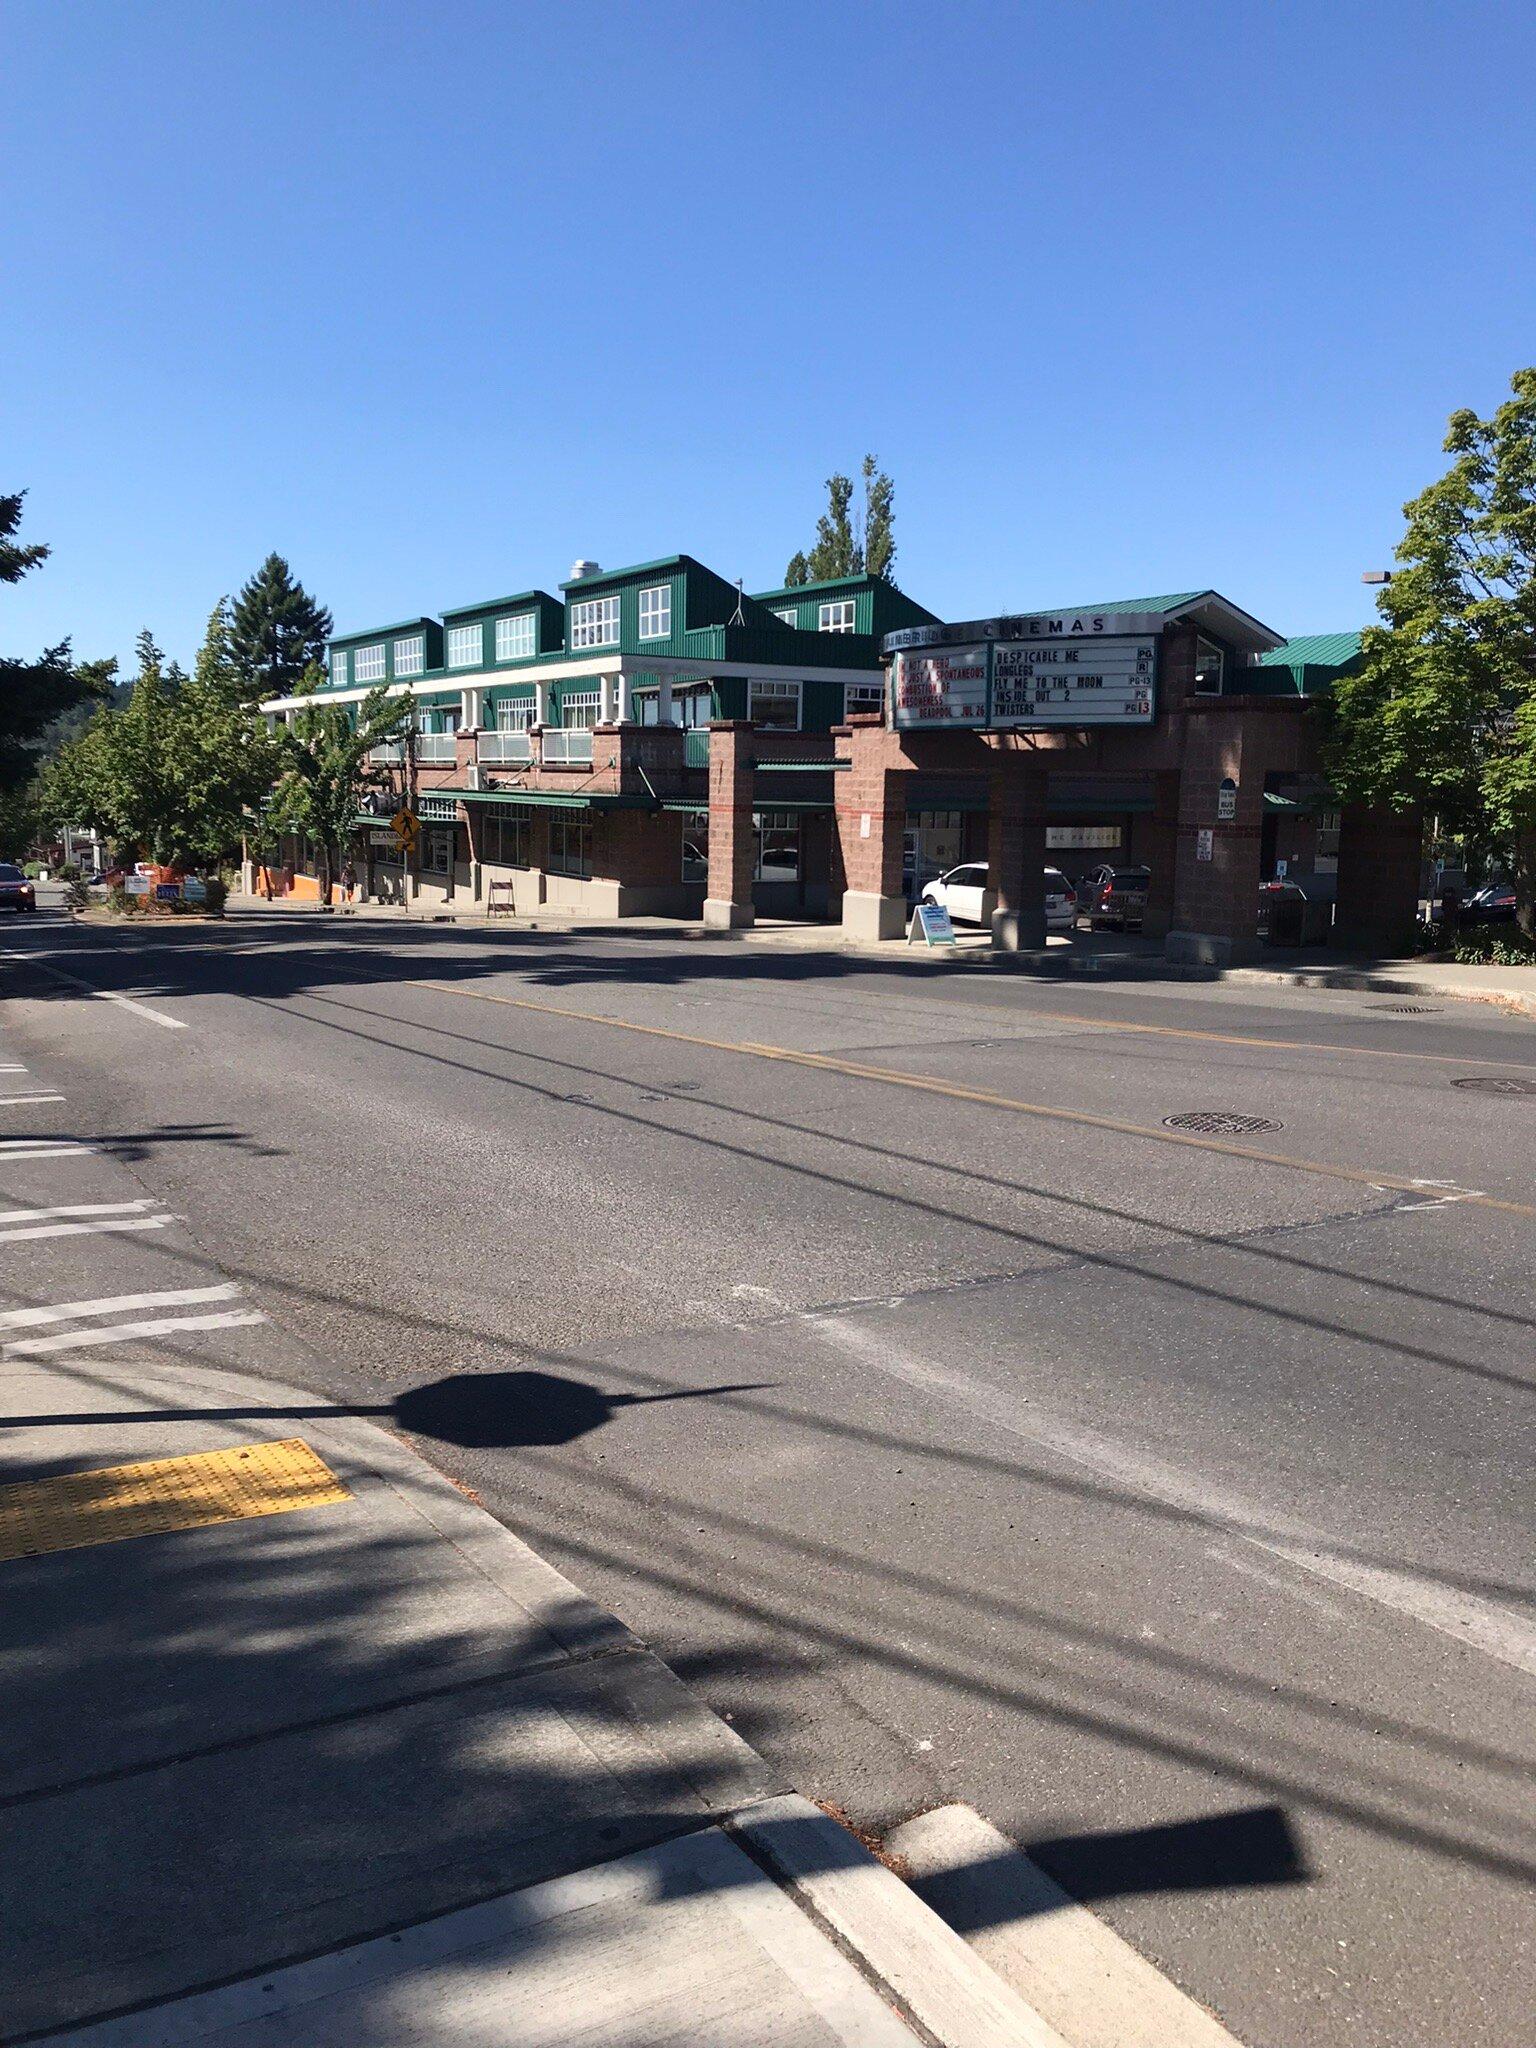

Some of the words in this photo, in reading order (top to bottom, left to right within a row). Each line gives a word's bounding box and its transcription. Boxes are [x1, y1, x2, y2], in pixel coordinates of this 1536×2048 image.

[984, 618, 1104, 636] CINEMAS
[997, 651, 1058, 664] DESPICABLE
[1065, 650, 1079, 662] ME
[994, 665, 1034, 677] LONGLEGS
[1139, 663, 1146, 671] R
[994, 677, 1008, 689] FLY
[1014, 677, 1028, 689] ME
[1036, 677, 1047, 688] TO
[1052, 676, 1068, 688] THE
[1077, 676, 1103, 688] MOON
[1129, 676, 1151, 685] PG-13
[1035, 690, 1051, 702] OUT
[1064, 690, 1071, 701] 2
[994, 704, 1035, 715] TWISTERS
